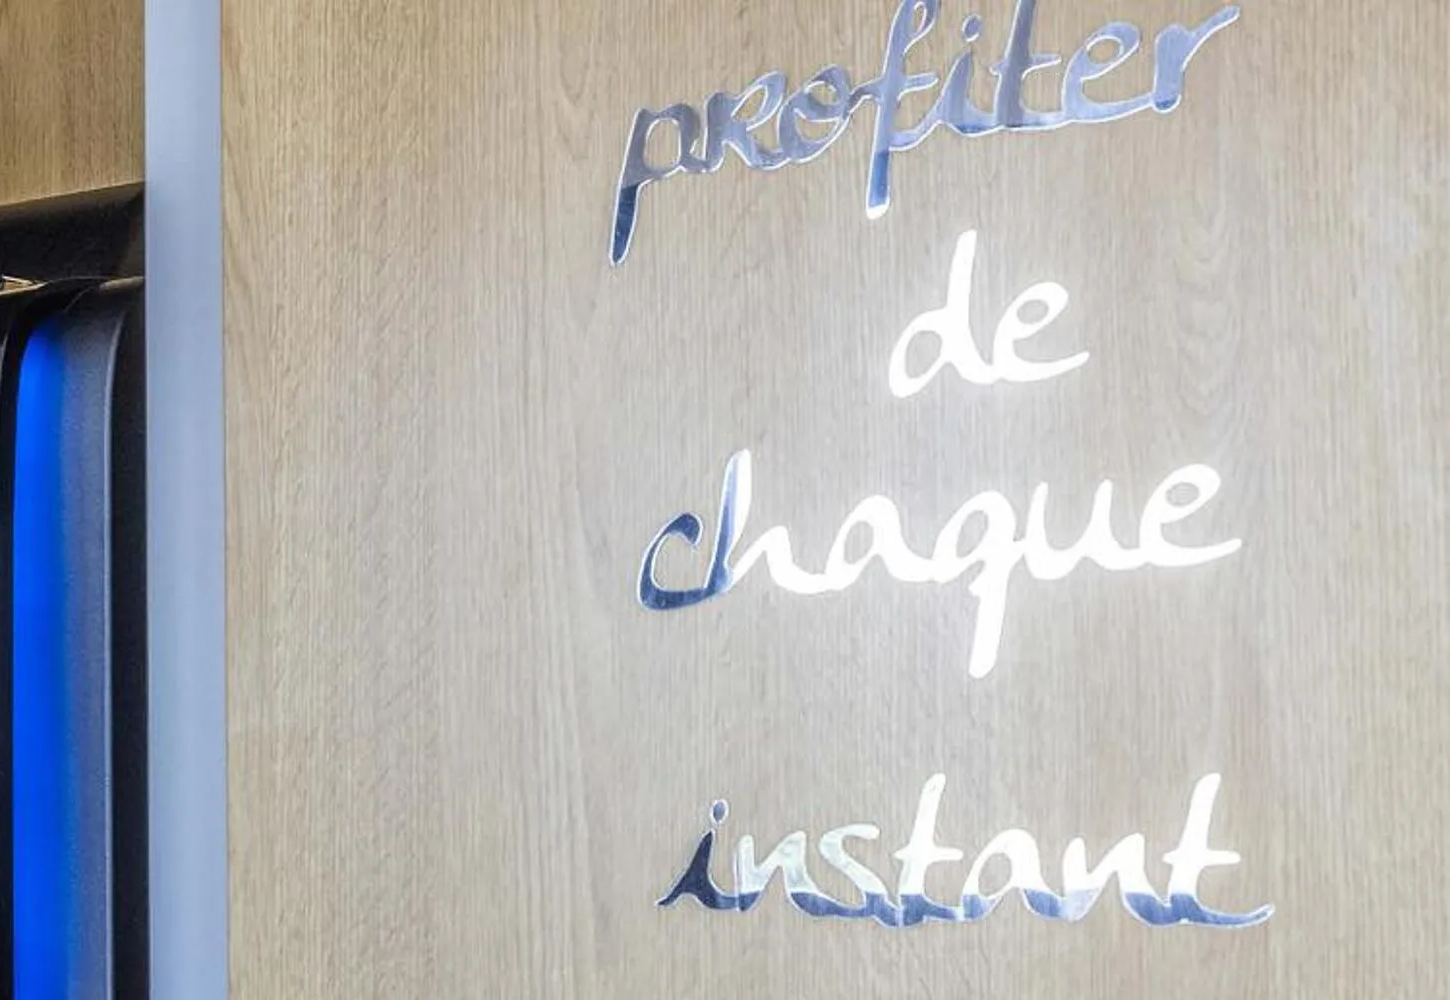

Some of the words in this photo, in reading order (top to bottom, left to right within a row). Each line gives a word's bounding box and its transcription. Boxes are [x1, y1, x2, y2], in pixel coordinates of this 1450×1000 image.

[608, 0, 1240, 266] profiter
[888, 229, 1090, 398] de
[637, 448, 1243, 679] chaque
[653, 772, 1276, 929] instant
